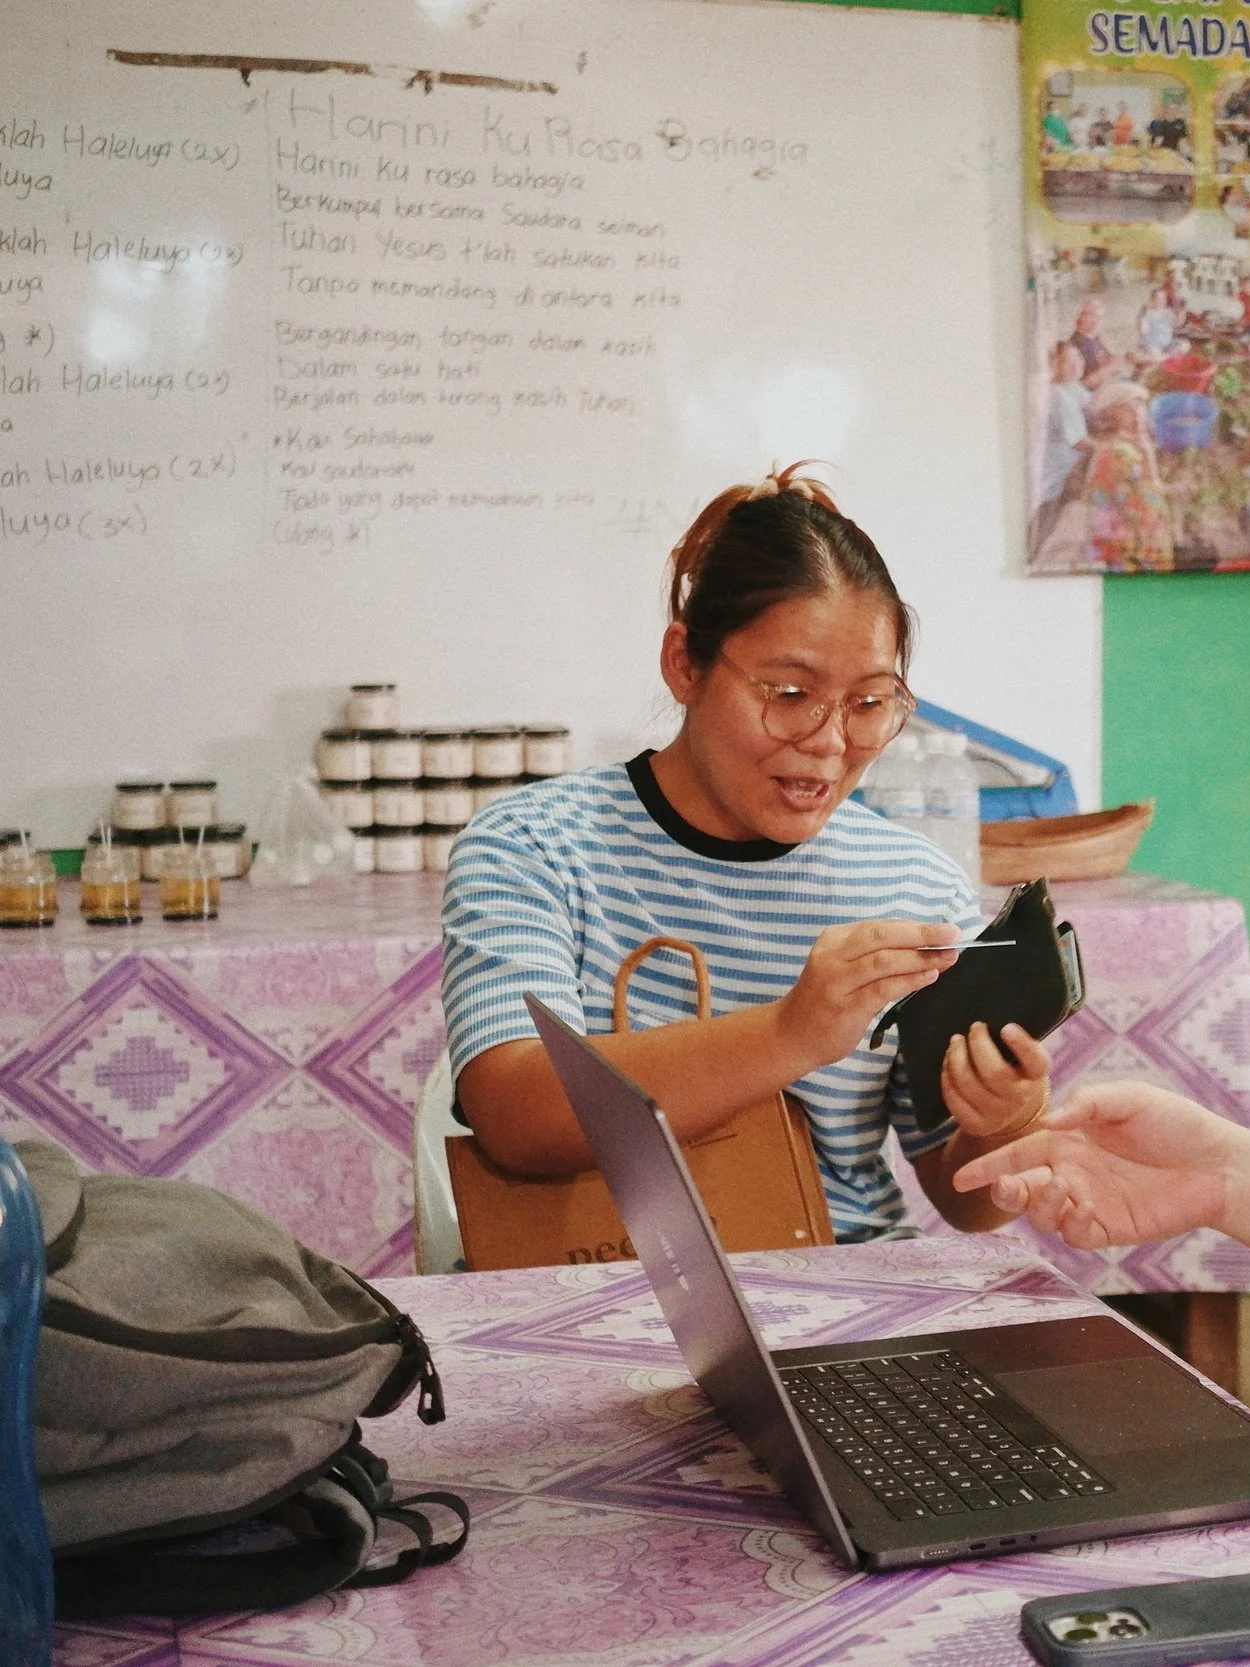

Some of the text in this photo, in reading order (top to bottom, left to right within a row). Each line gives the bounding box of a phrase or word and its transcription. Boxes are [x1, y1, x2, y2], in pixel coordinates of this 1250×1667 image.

[544, 116, 644, 163] Rasa
[277, 220, 357, 255] Tuhan
[279, 264, 360, 300] Tanpa
